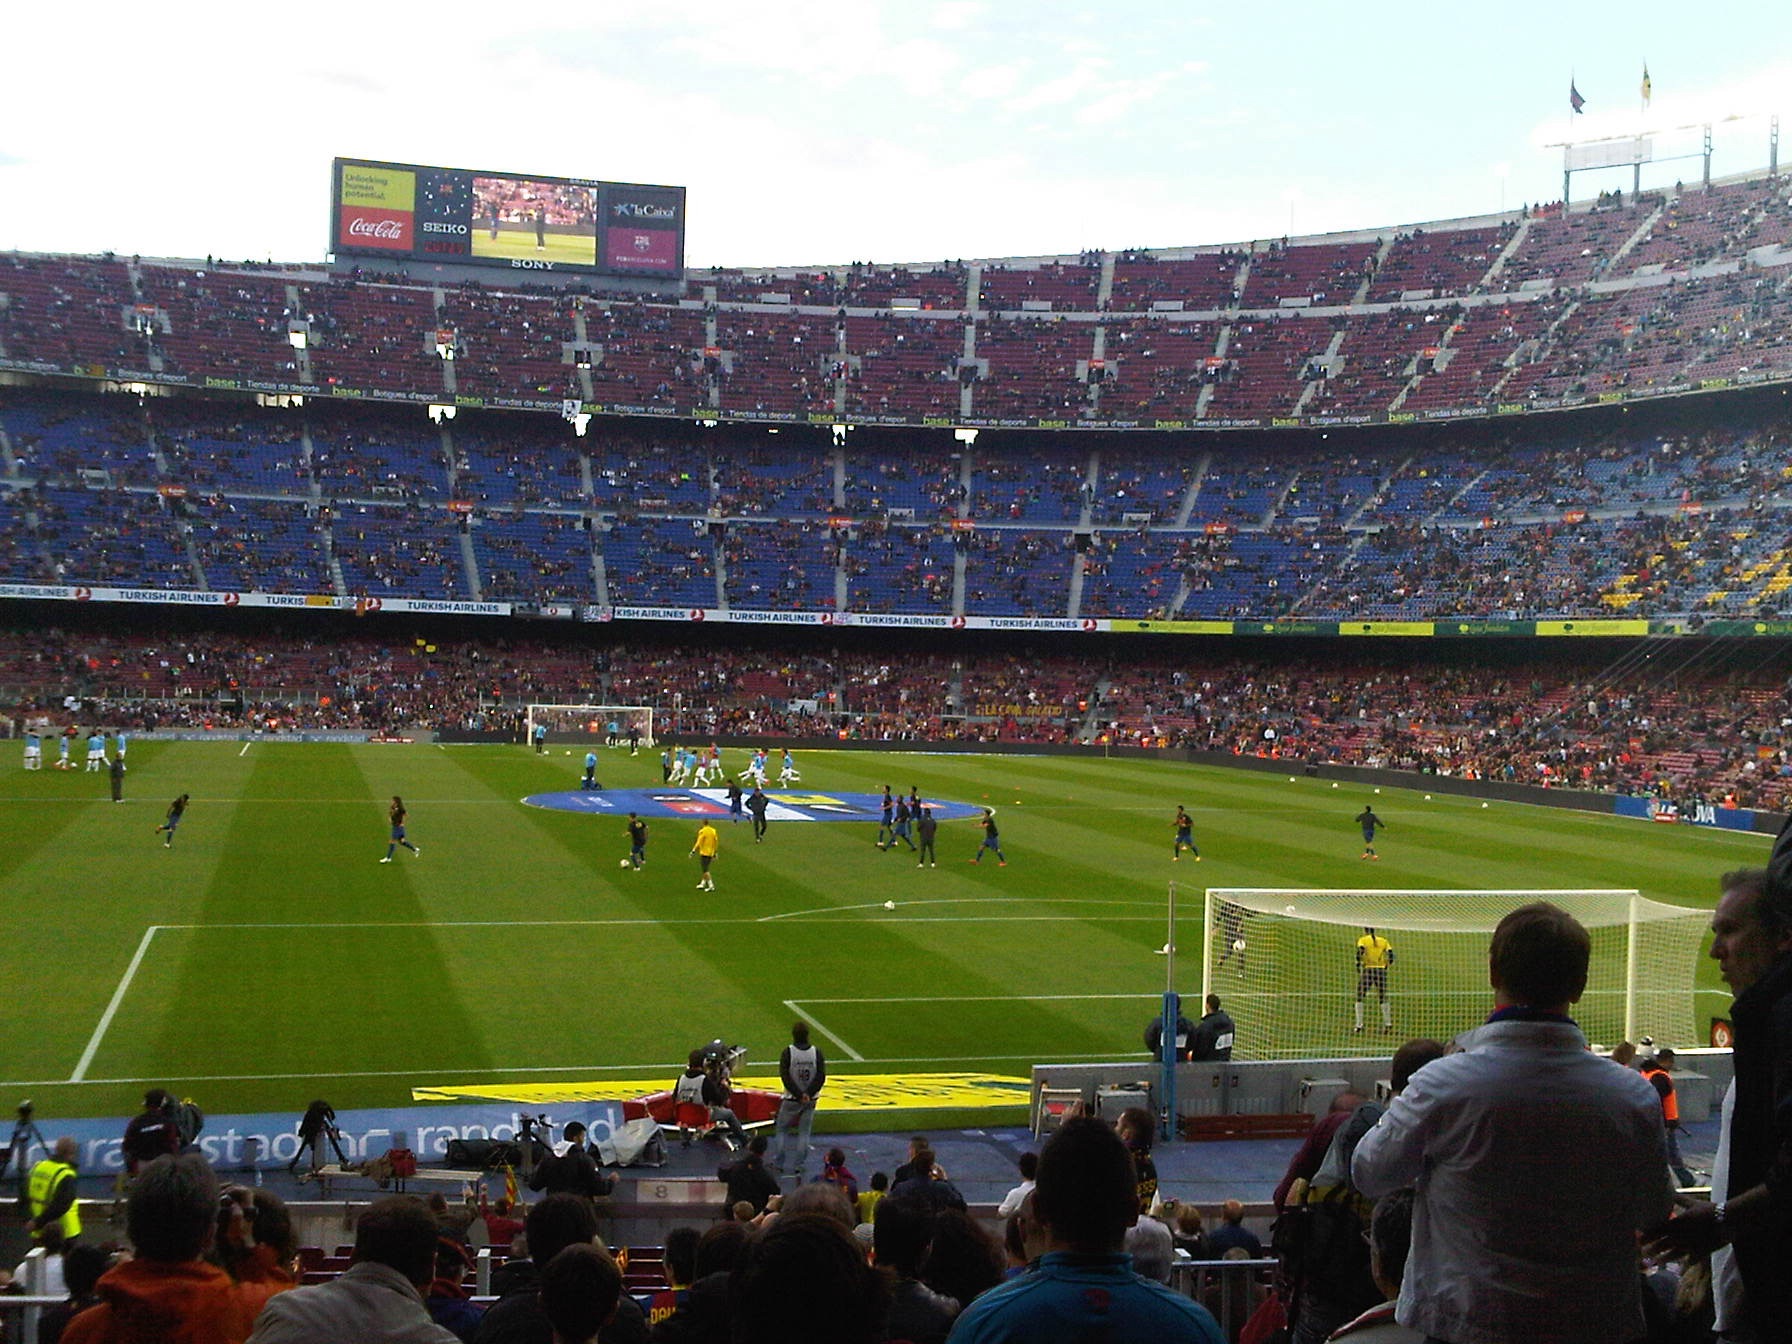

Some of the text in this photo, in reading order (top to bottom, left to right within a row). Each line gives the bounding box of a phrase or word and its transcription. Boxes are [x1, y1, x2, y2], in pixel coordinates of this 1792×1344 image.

[423, 222, 467, 234] SEIKO
[512, 259, 555, 270] SONY
[18, 587, 69, 598] AIRLINES
[119, 591, 218, 603] TURKISH AIRLINES
[266, 596, 305, 606] TURKIS
[407, 601, 499, 612] TURKISH AIRLINES
[640, 609, 685, 619] AIRLINES
[728, 612, 816, 623] TURKISH AIRLINES
[859, 616, 947, 626] TURKISH AIRLINES
[989, 619, 1078, 629] TURKISH AIRLINES
[85, 1120, 304, 1169] rastad
[656, 1185, 667, 1199] 8
